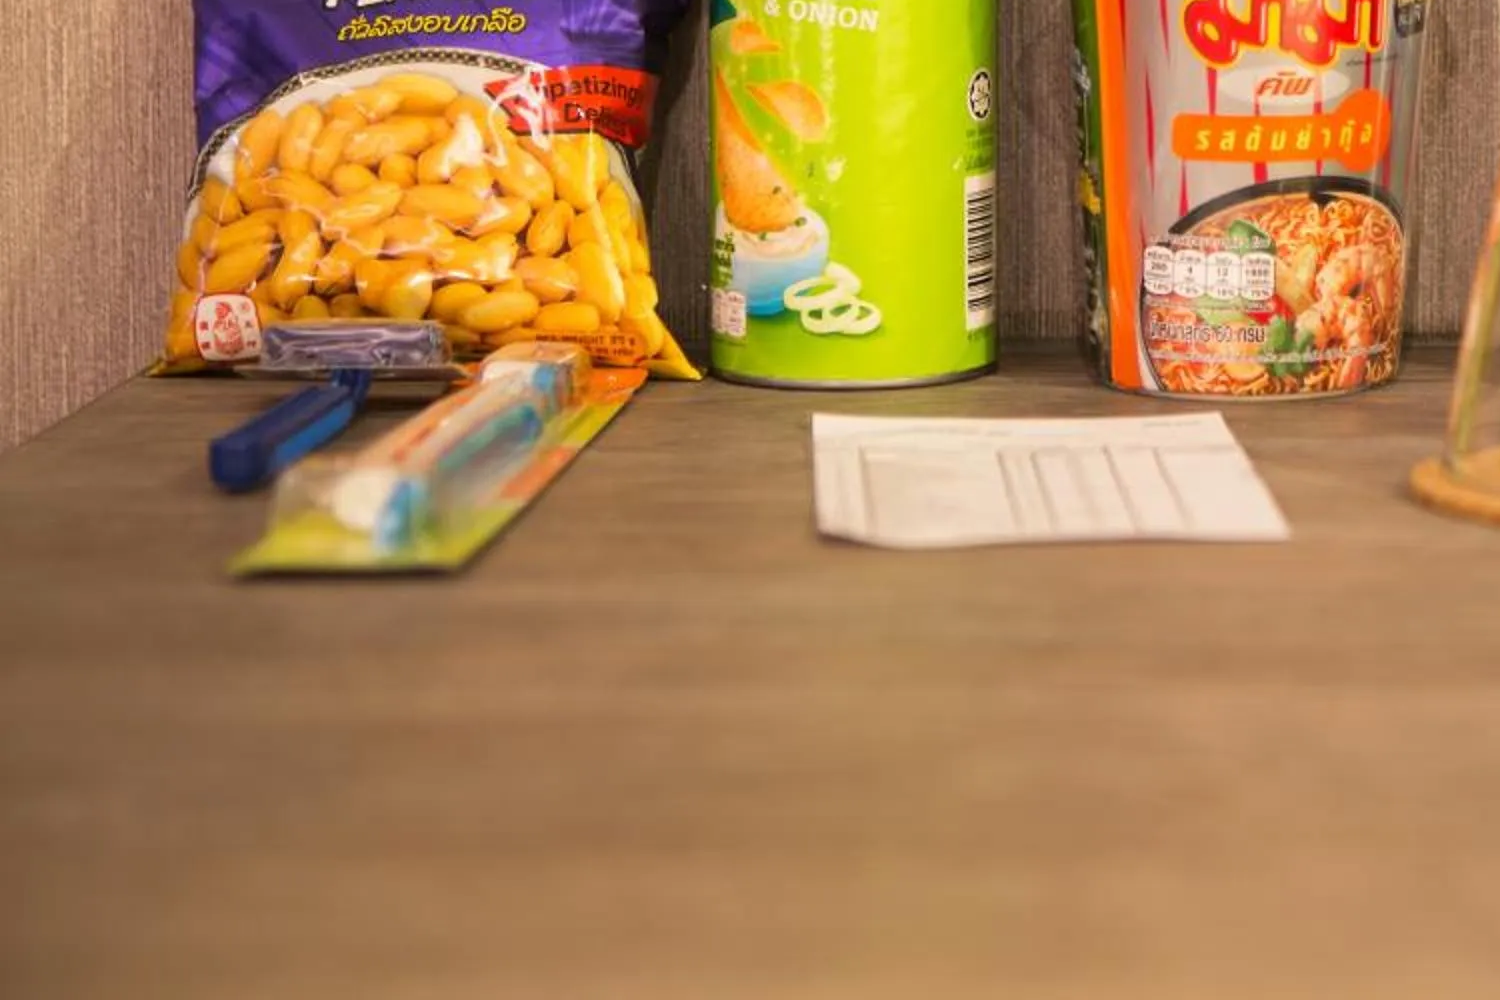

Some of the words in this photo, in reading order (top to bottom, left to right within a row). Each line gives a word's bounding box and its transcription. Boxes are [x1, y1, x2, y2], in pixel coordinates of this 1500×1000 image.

[338, 7, 526, 41] ถั่วลิสงอบเกลือ
[788, 1, 879, 32] ONION
[1256, 71, 1314, 96] คัพ
